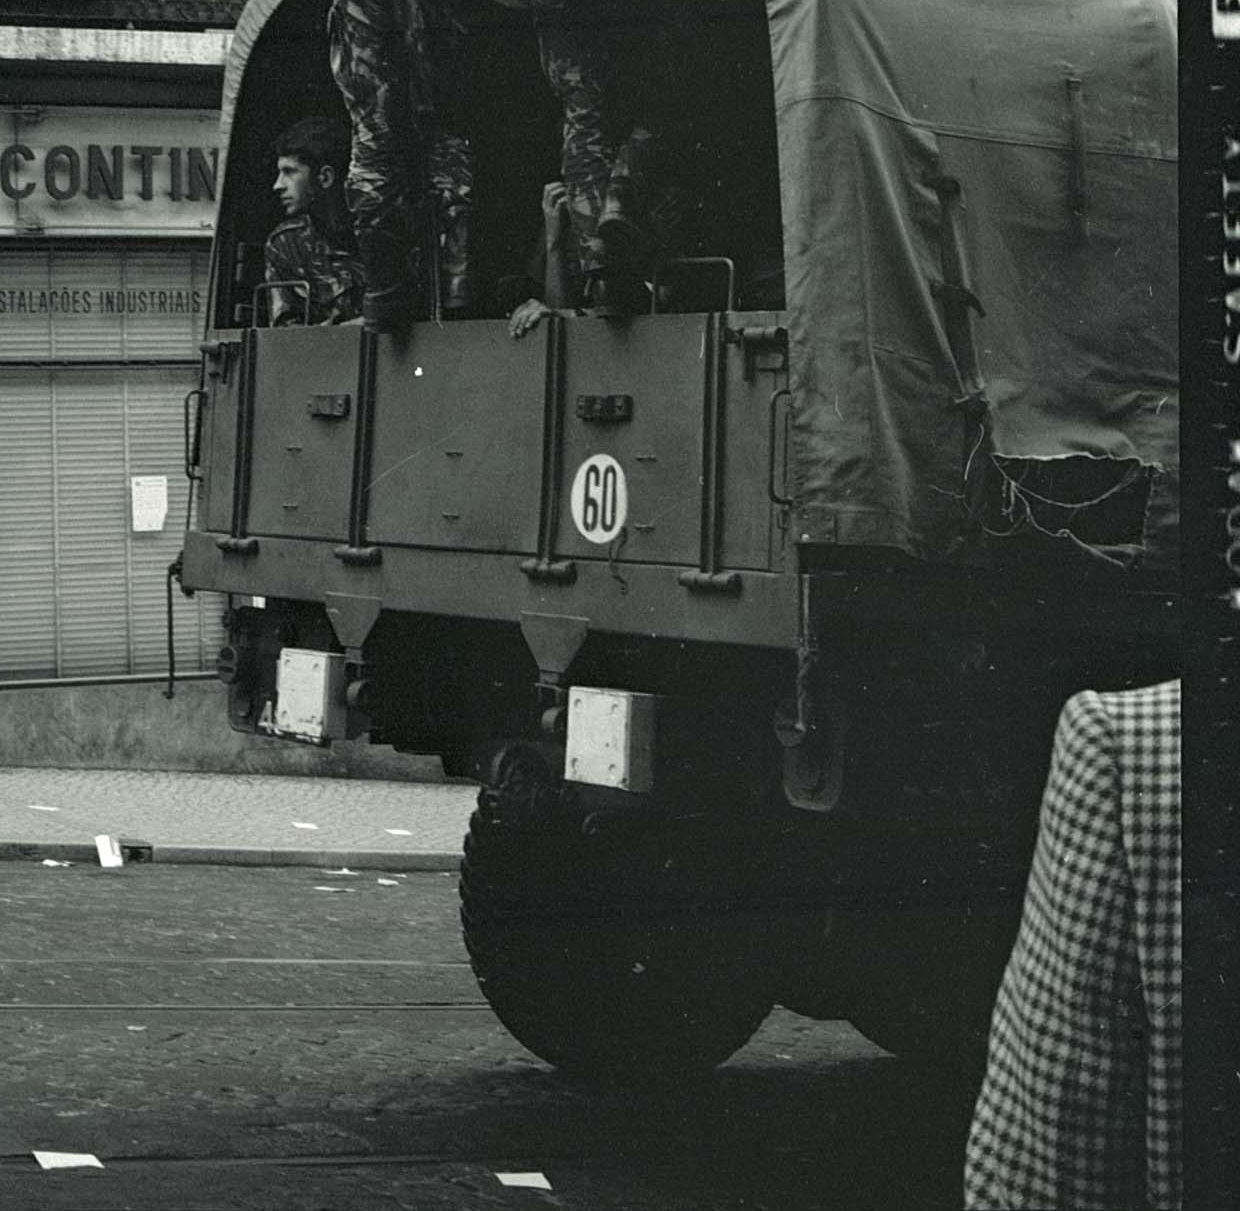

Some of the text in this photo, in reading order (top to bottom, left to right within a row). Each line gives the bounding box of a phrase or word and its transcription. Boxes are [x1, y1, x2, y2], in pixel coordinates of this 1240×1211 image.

[0, 143, 219, 202] CONTIN
[99, 289, 201, 314] INDUSTRIAIS
[582, 464, 617, 533] 60
